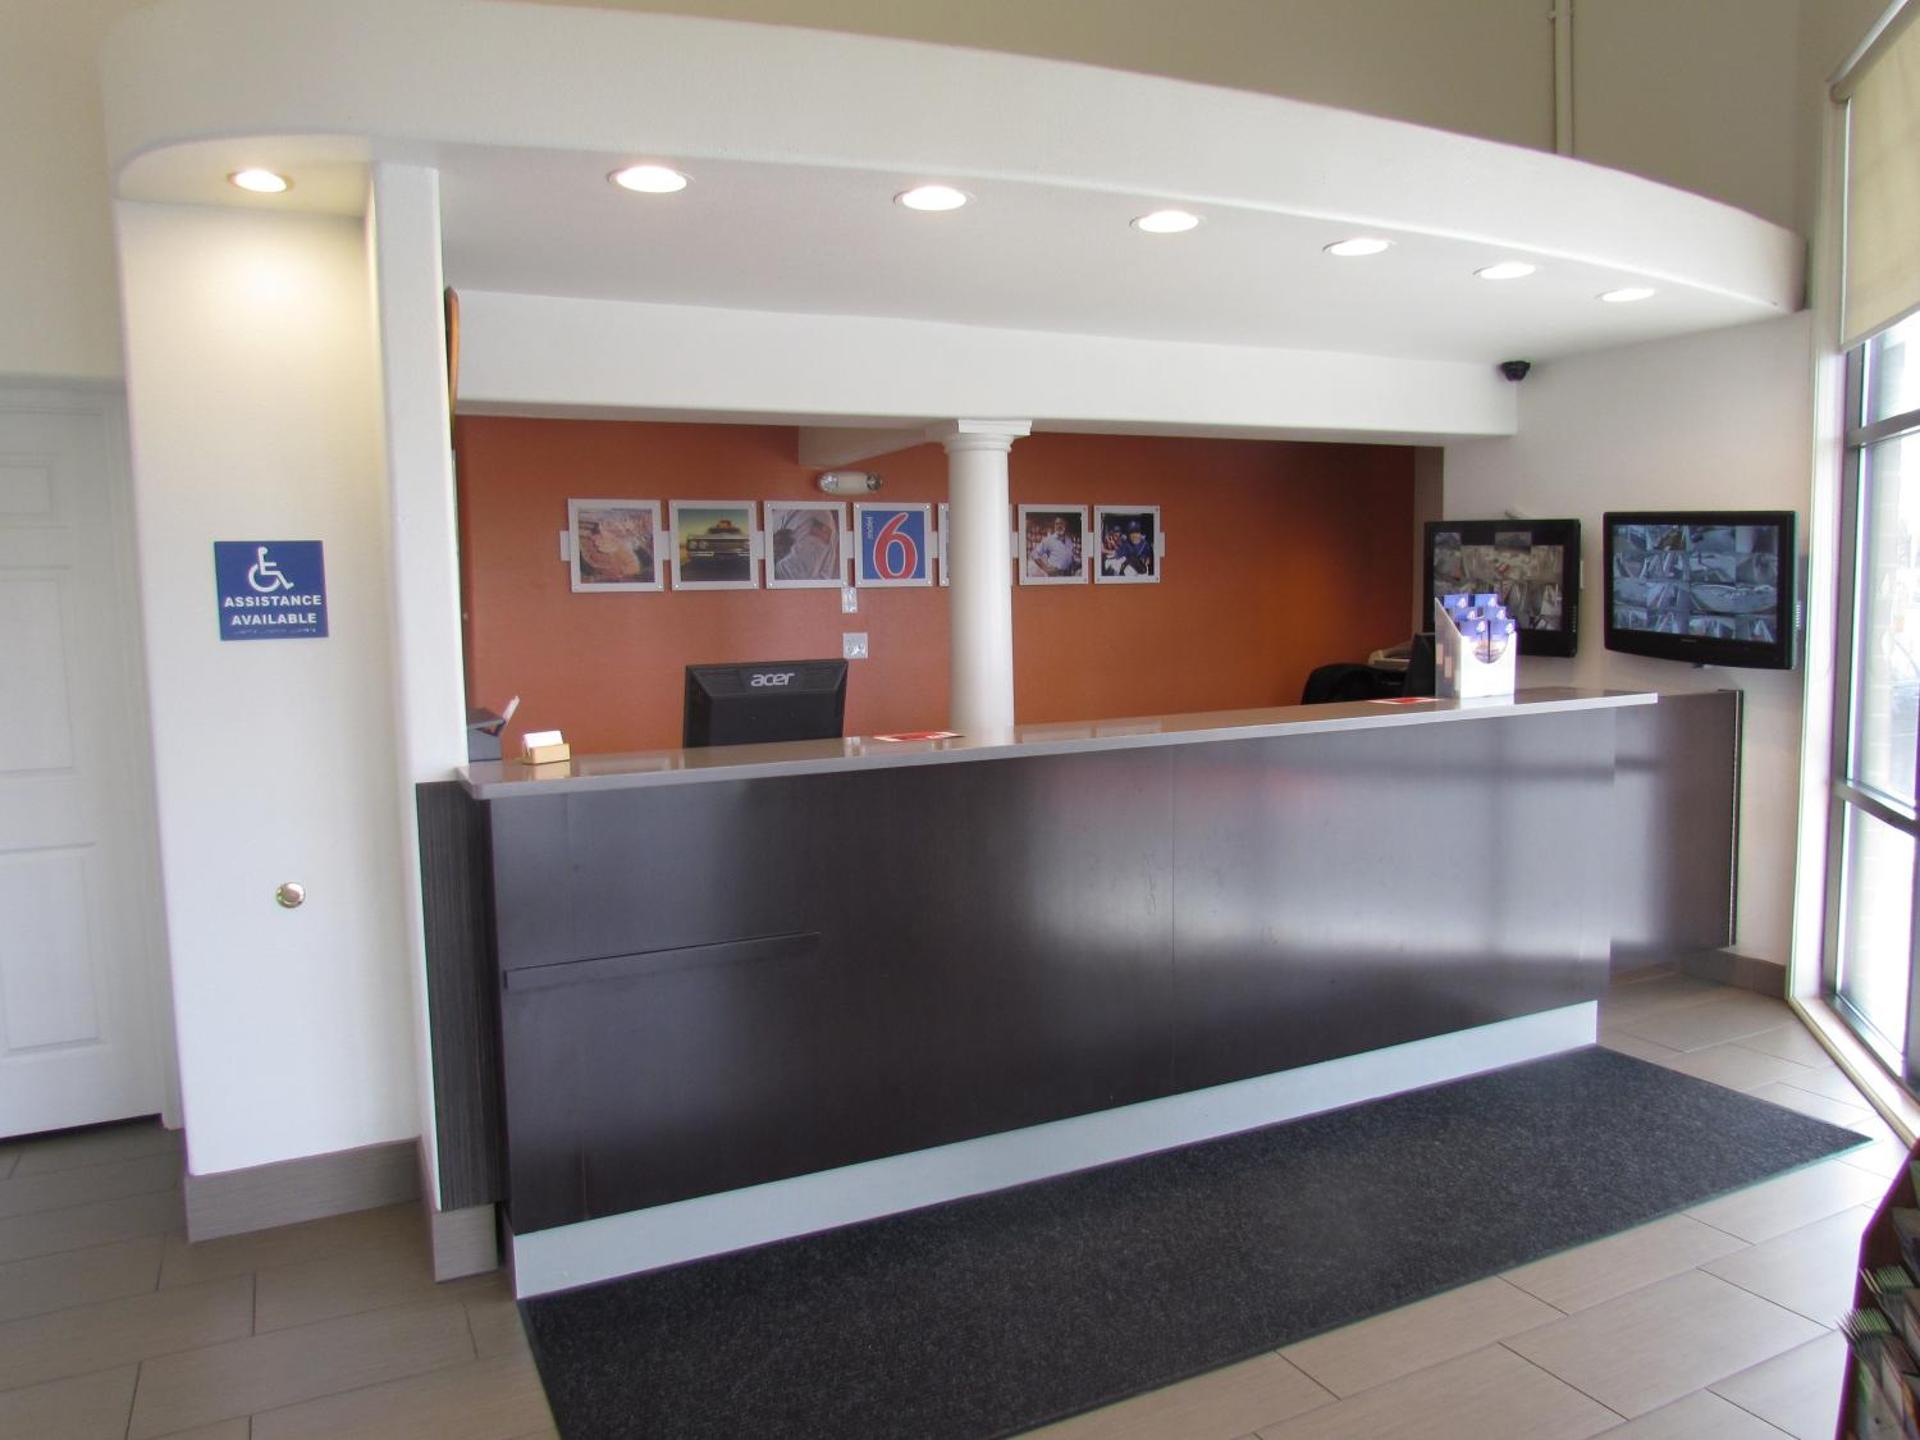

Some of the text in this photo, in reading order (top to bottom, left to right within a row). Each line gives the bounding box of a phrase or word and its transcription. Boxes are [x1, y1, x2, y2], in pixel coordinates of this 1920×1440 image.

[873, 512, 918, 580] 6
[224, 595, 322, 608] ASSISTANCE
[231, 613, 317, 626] AVAILABLE
[750, 672, 795, 687] acer
